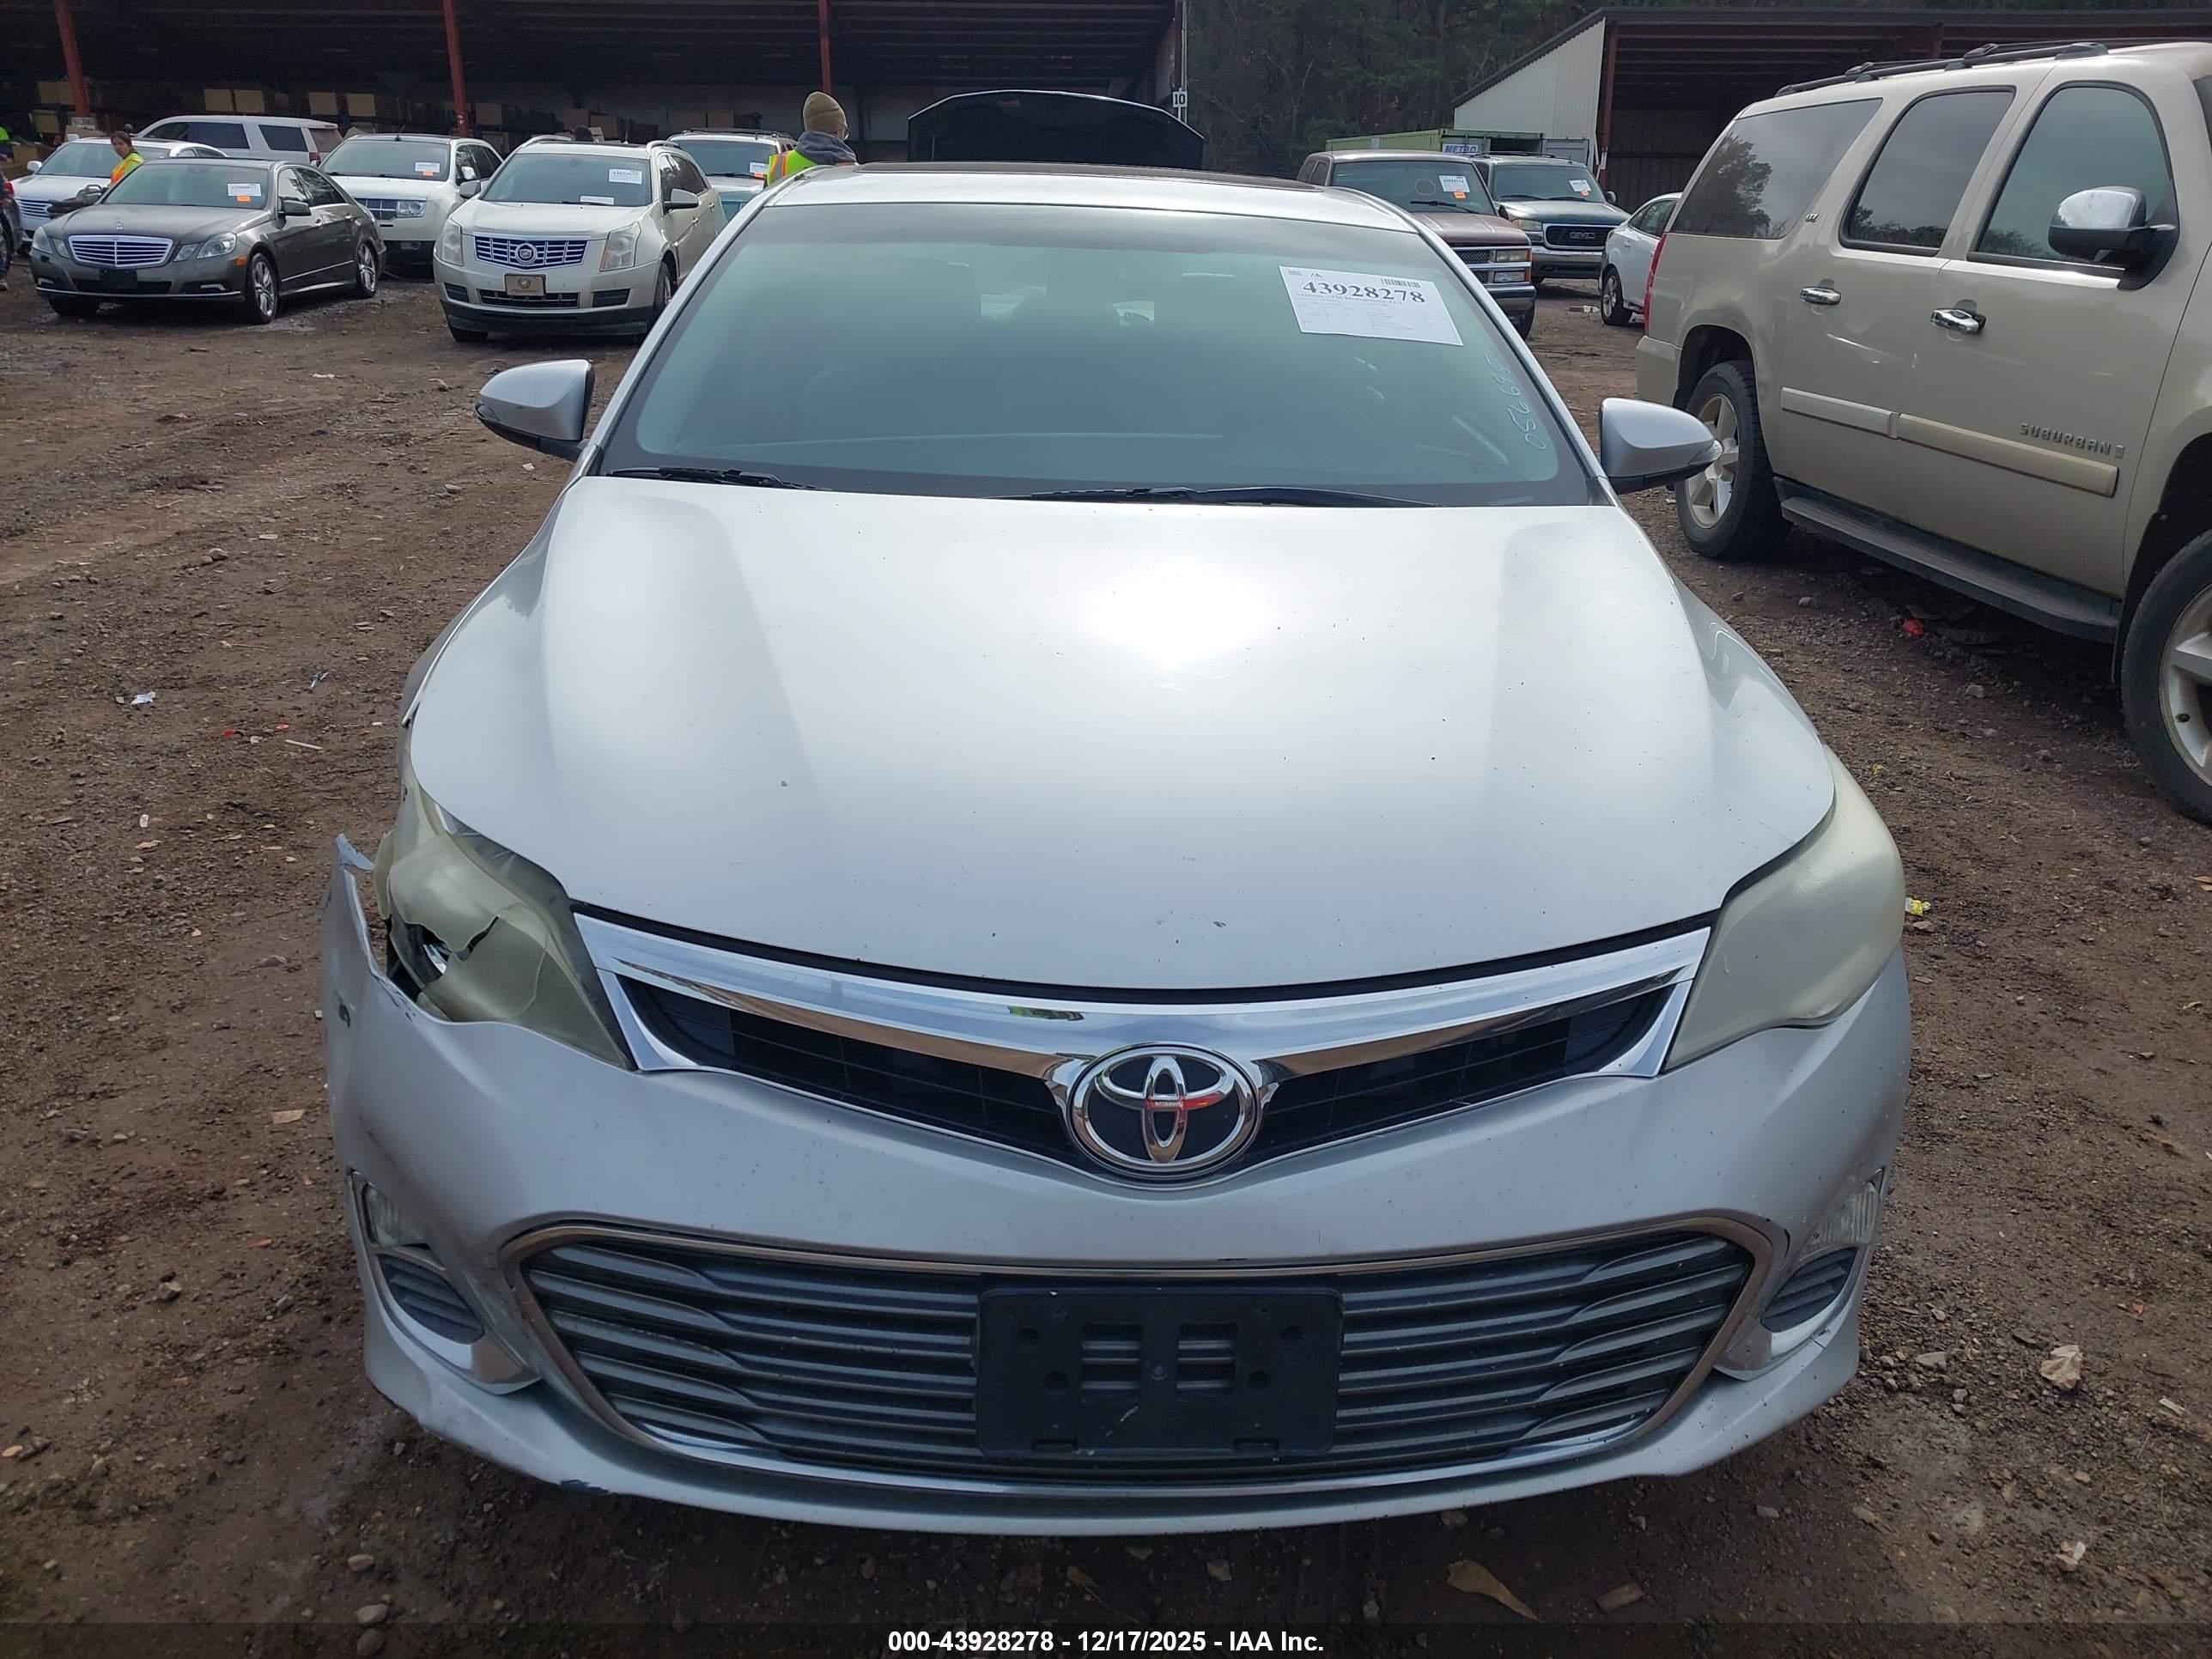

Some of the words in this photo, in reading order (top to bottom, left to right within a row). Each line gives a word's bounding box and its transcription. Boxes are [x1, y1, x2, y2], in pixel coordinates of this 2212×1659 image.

[1174, 94, 1186, 105] 10
[1444, 144, 1477, 154] METRO
[1303, 281, 1426, 304] 43928278
[2020, 422, 2112, 456] SUBURBAN
